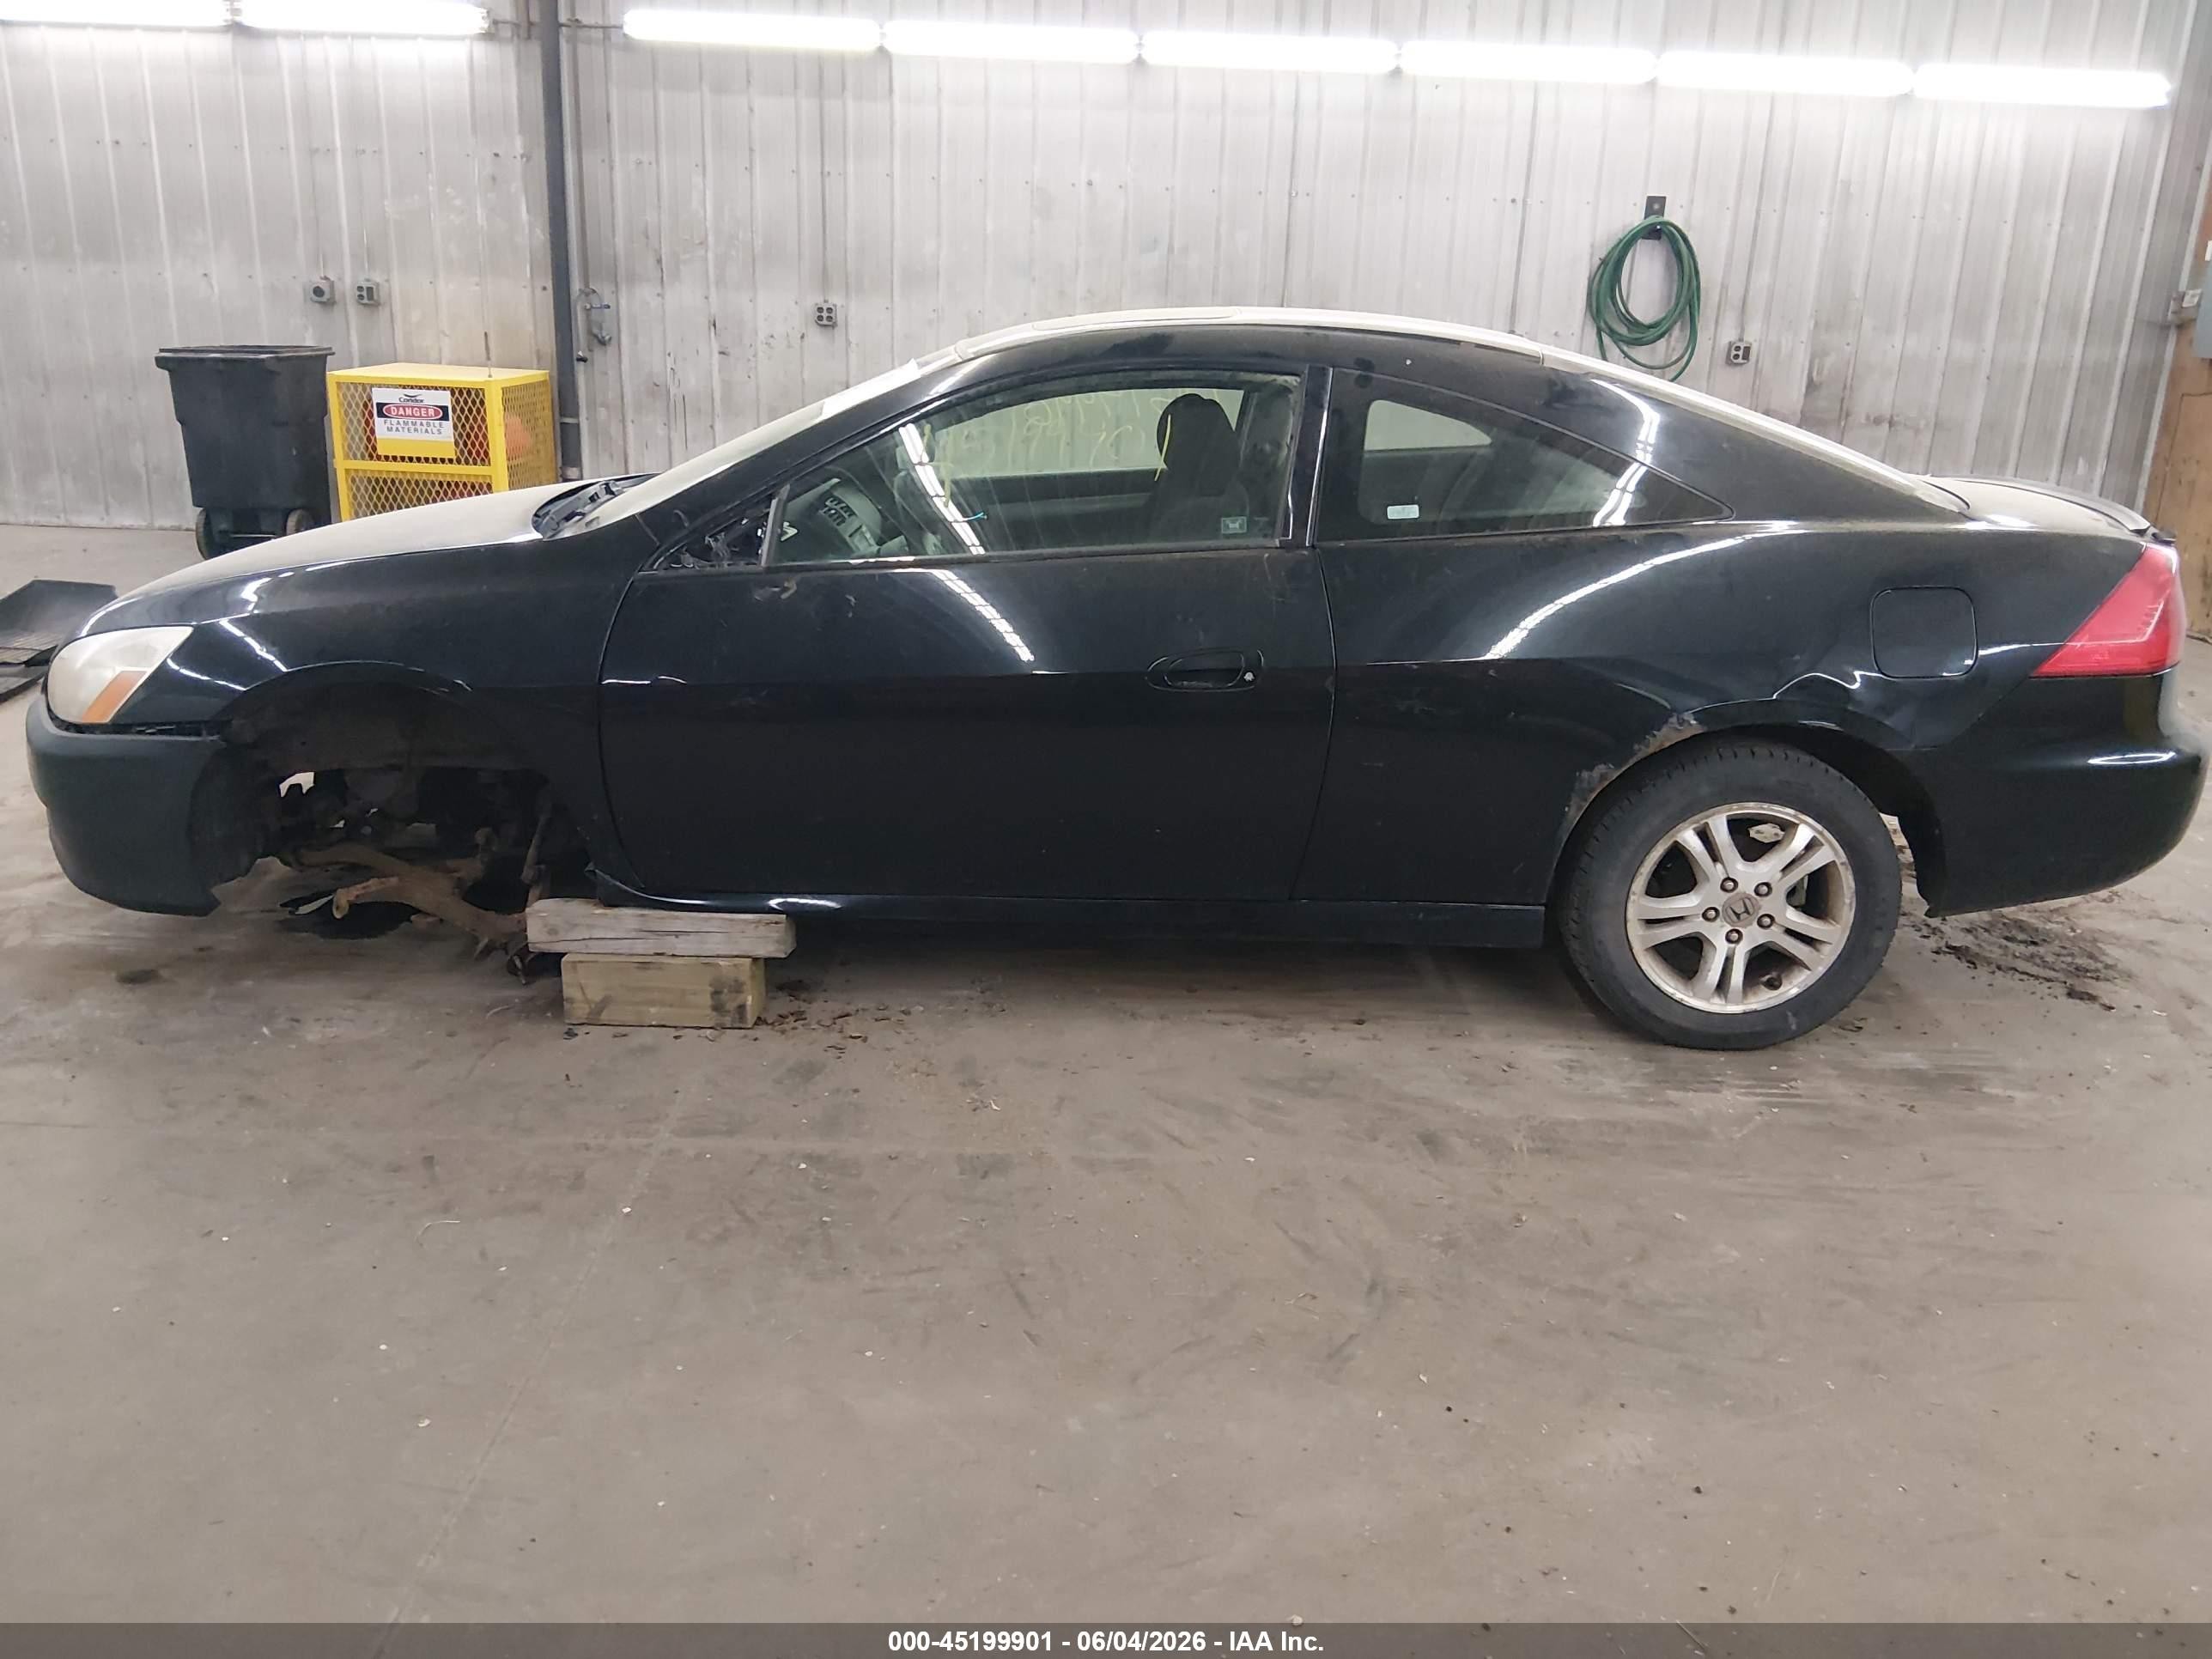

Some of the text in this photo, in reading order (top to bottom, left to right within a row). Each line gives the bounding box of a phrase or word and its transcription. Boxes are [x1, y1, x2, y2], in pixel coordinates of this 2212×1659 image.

[390, 406, 435, 417] DANGER
[383, 419, 445, 428] FLAMMABLE
[386, 426, 443, 435] MATERIALS
